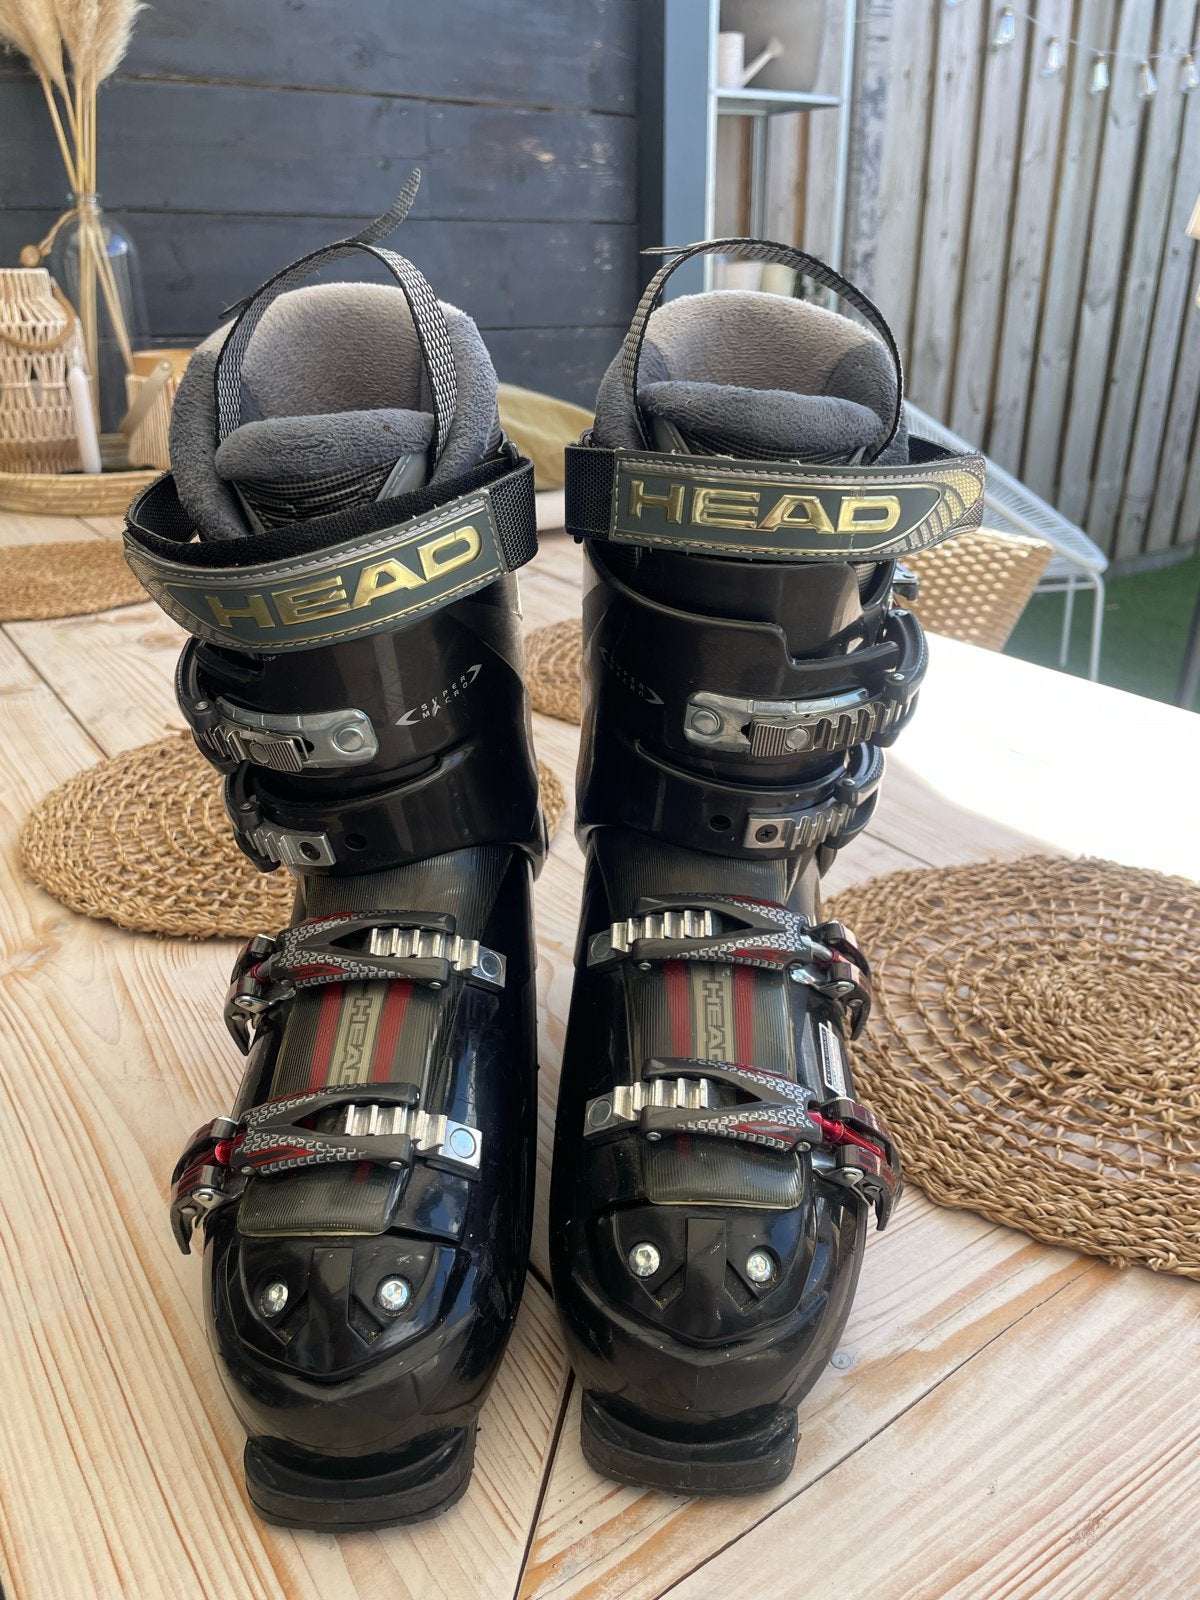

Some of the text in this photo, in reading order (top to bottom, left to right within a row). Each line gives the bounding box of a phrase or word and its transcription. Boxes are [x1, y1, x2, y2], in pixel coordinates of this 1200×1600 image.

[628, 480, 901, 534] HEAD
[205, 525, 482, 629] HEAD
[420, 675, 466, 712] SUPER
[421, 681, 468, 719] MACRO
